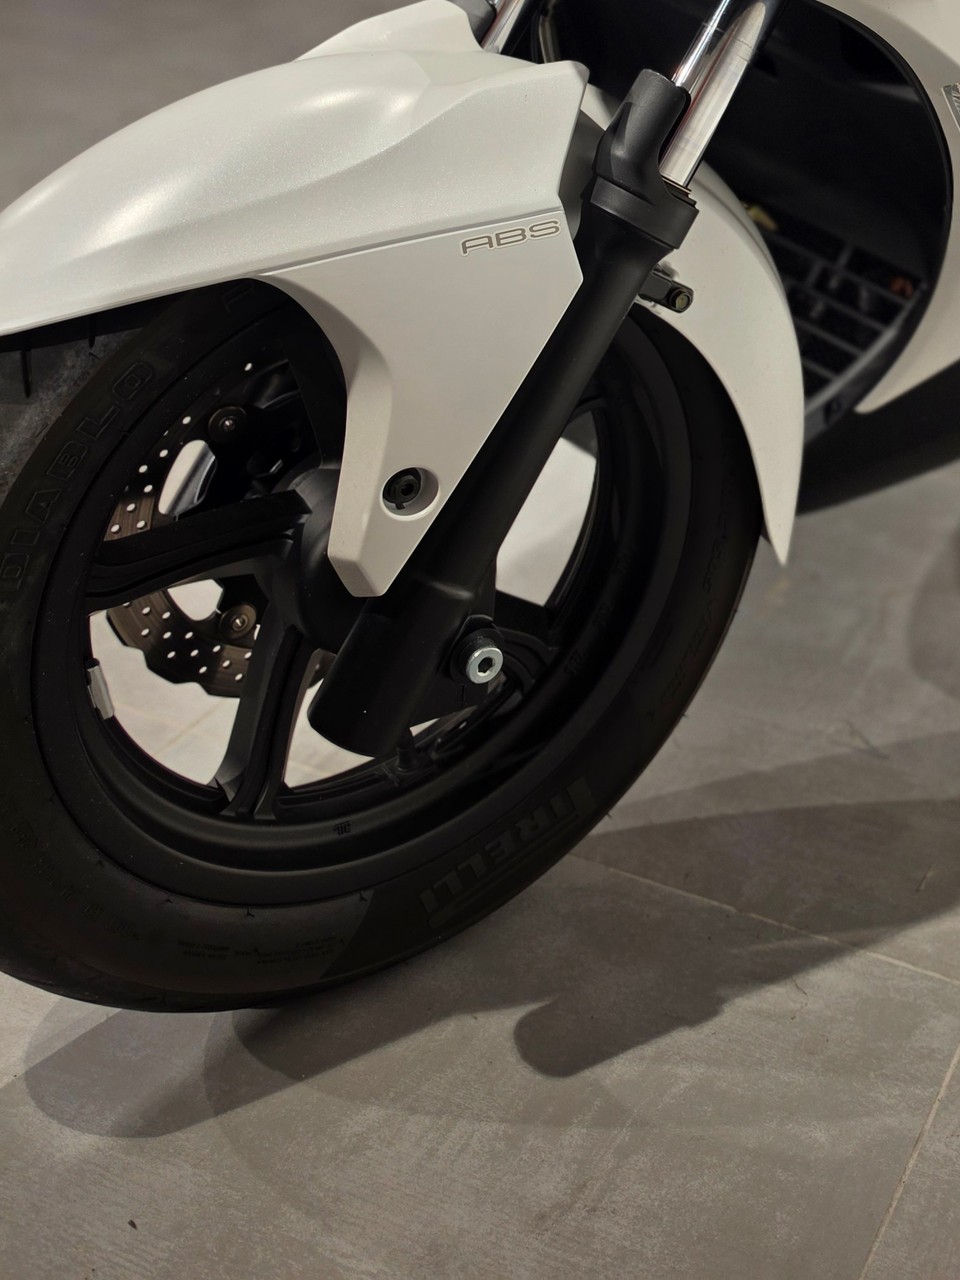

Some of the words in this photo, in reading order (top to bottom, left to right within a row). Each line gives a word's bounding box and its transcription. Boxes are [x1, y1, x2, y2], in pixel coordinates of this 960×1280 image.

[461, 220, 560, 255] ABS
[0, 360, 155, 592] DIABLO
[419, 776, 598, 929] PIRELLI
